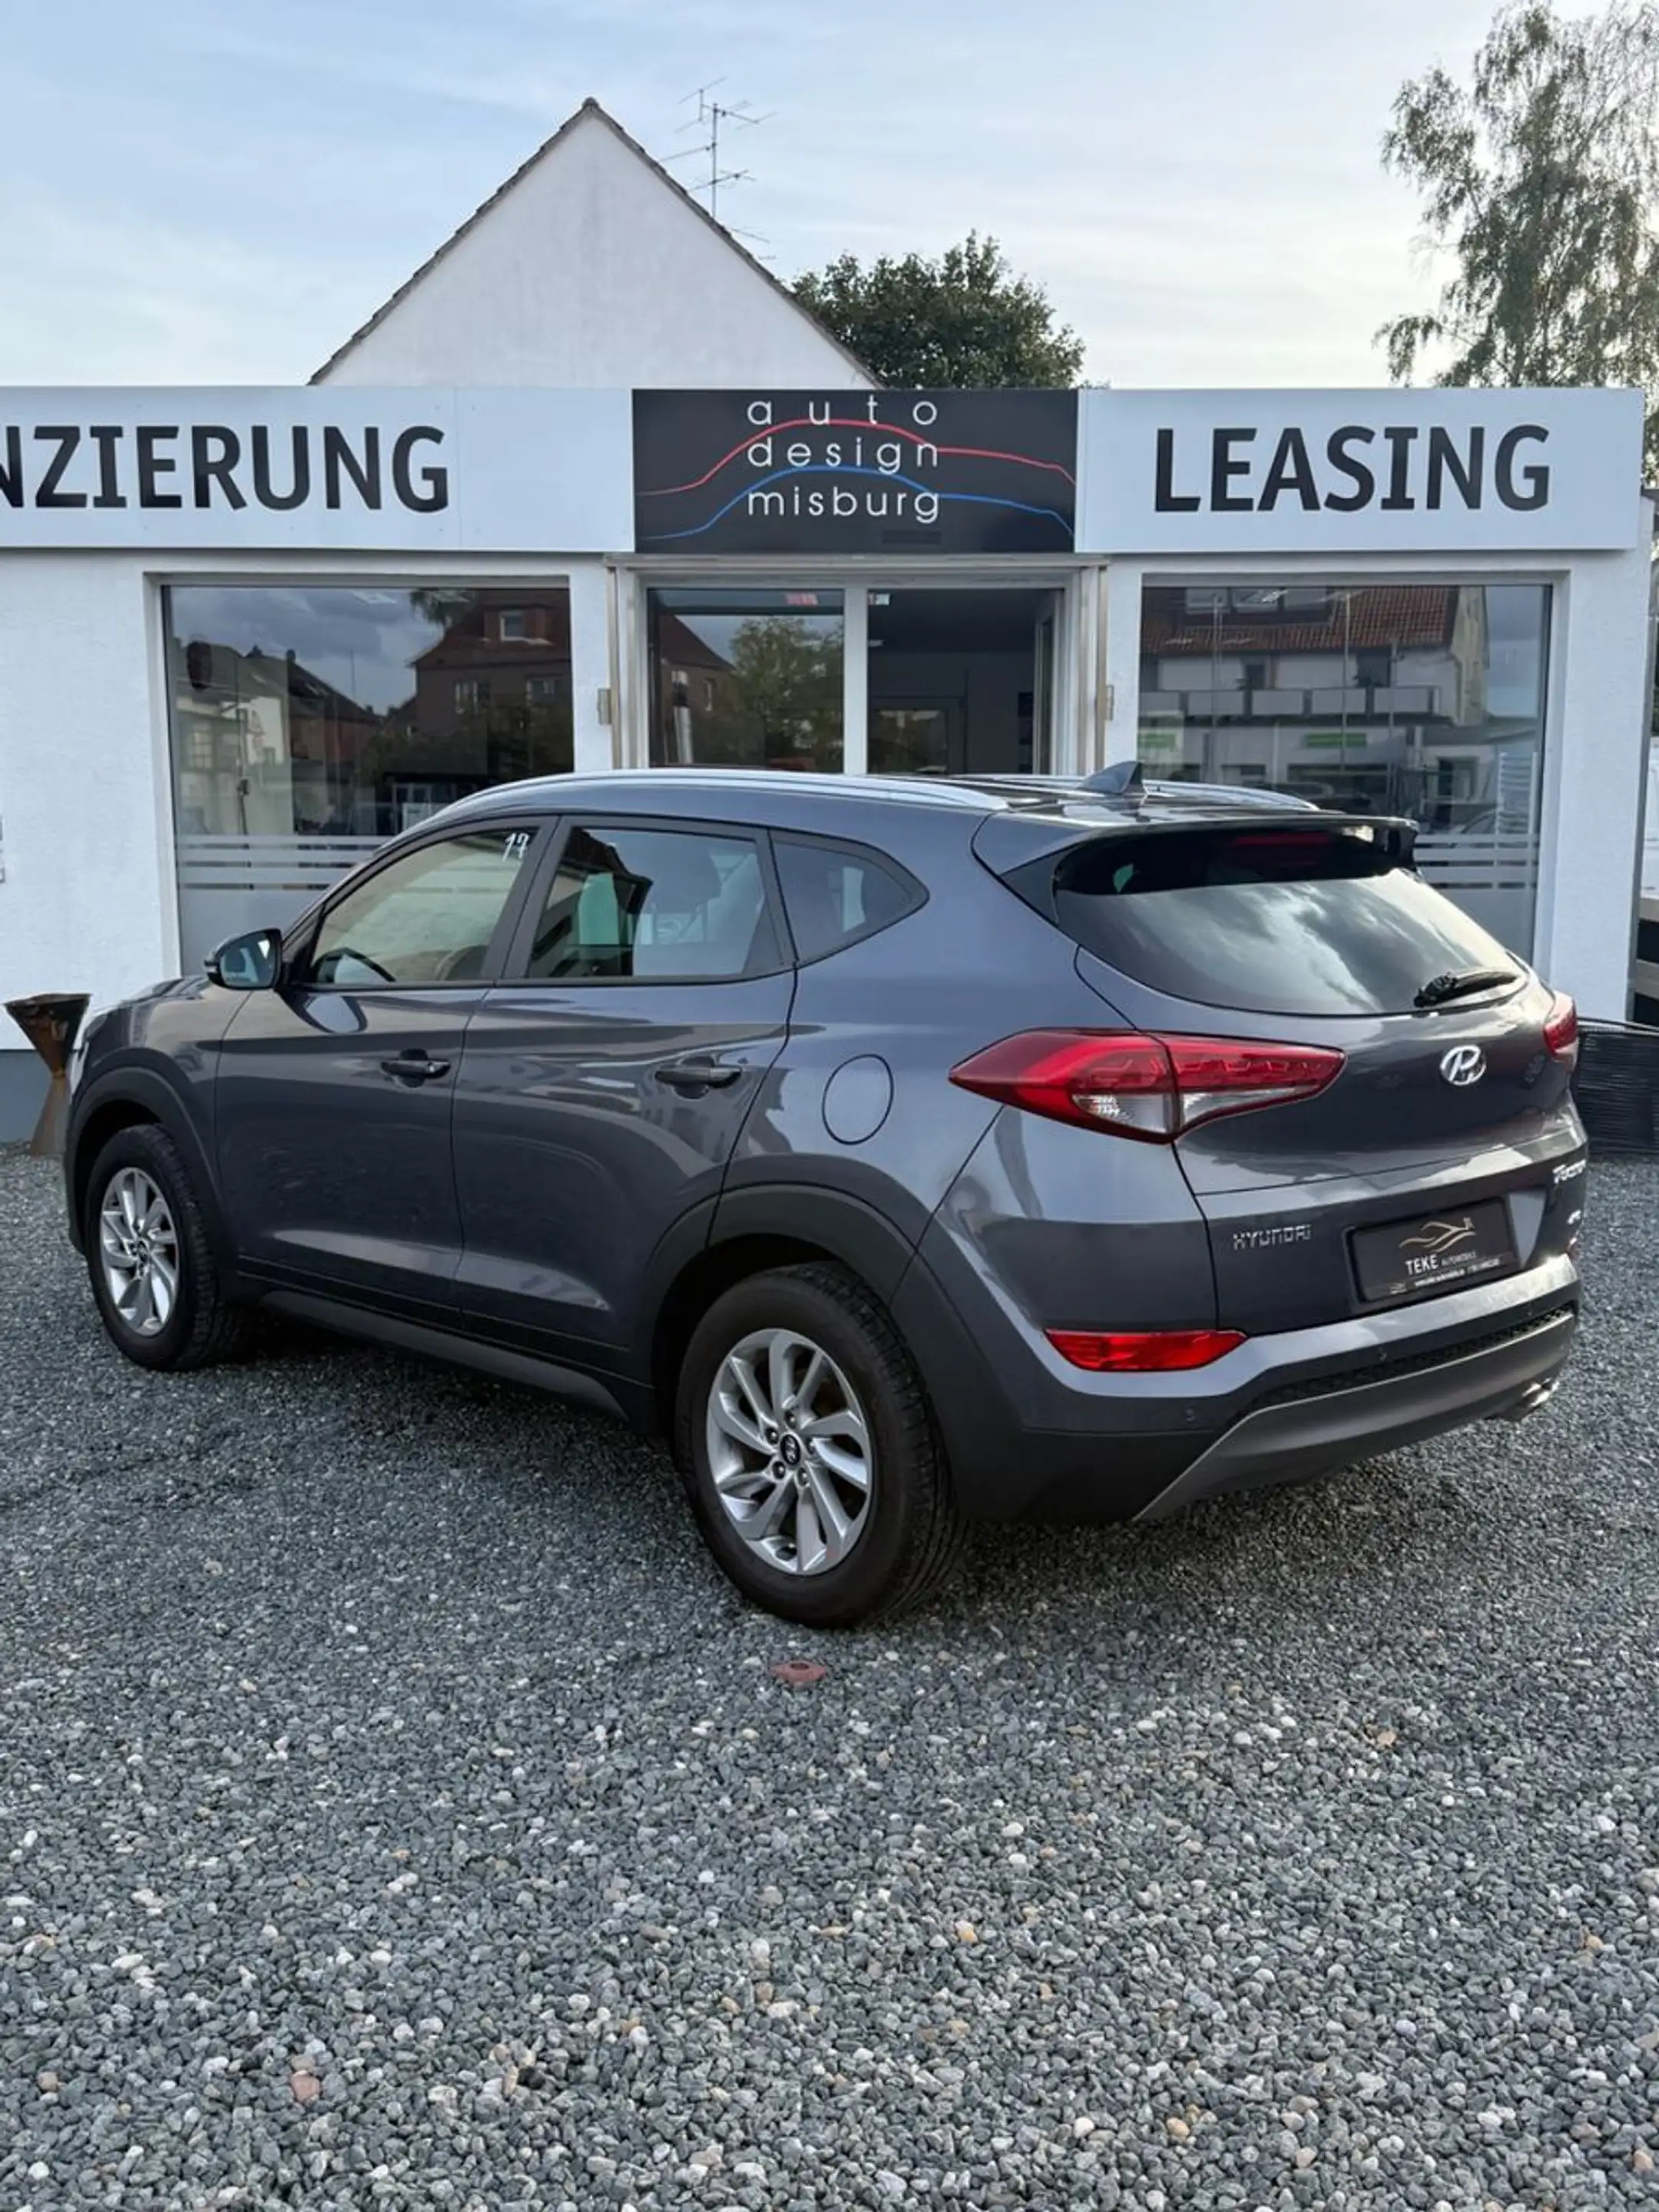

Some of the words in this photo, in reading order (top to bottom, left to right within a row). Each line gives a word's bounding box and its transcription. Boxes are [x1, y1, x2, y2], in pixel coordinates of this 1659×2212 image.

[747, 394, 938, 425] auto
[747, 436, 938, 475] design
[1154, 424, 1550, 512] LEASING
[747, 486, 939, 524] misburg
[1233, 1224, 1312, 1250] HYUNDAI
[1404, 1253, 1439, 1276] TEKE
